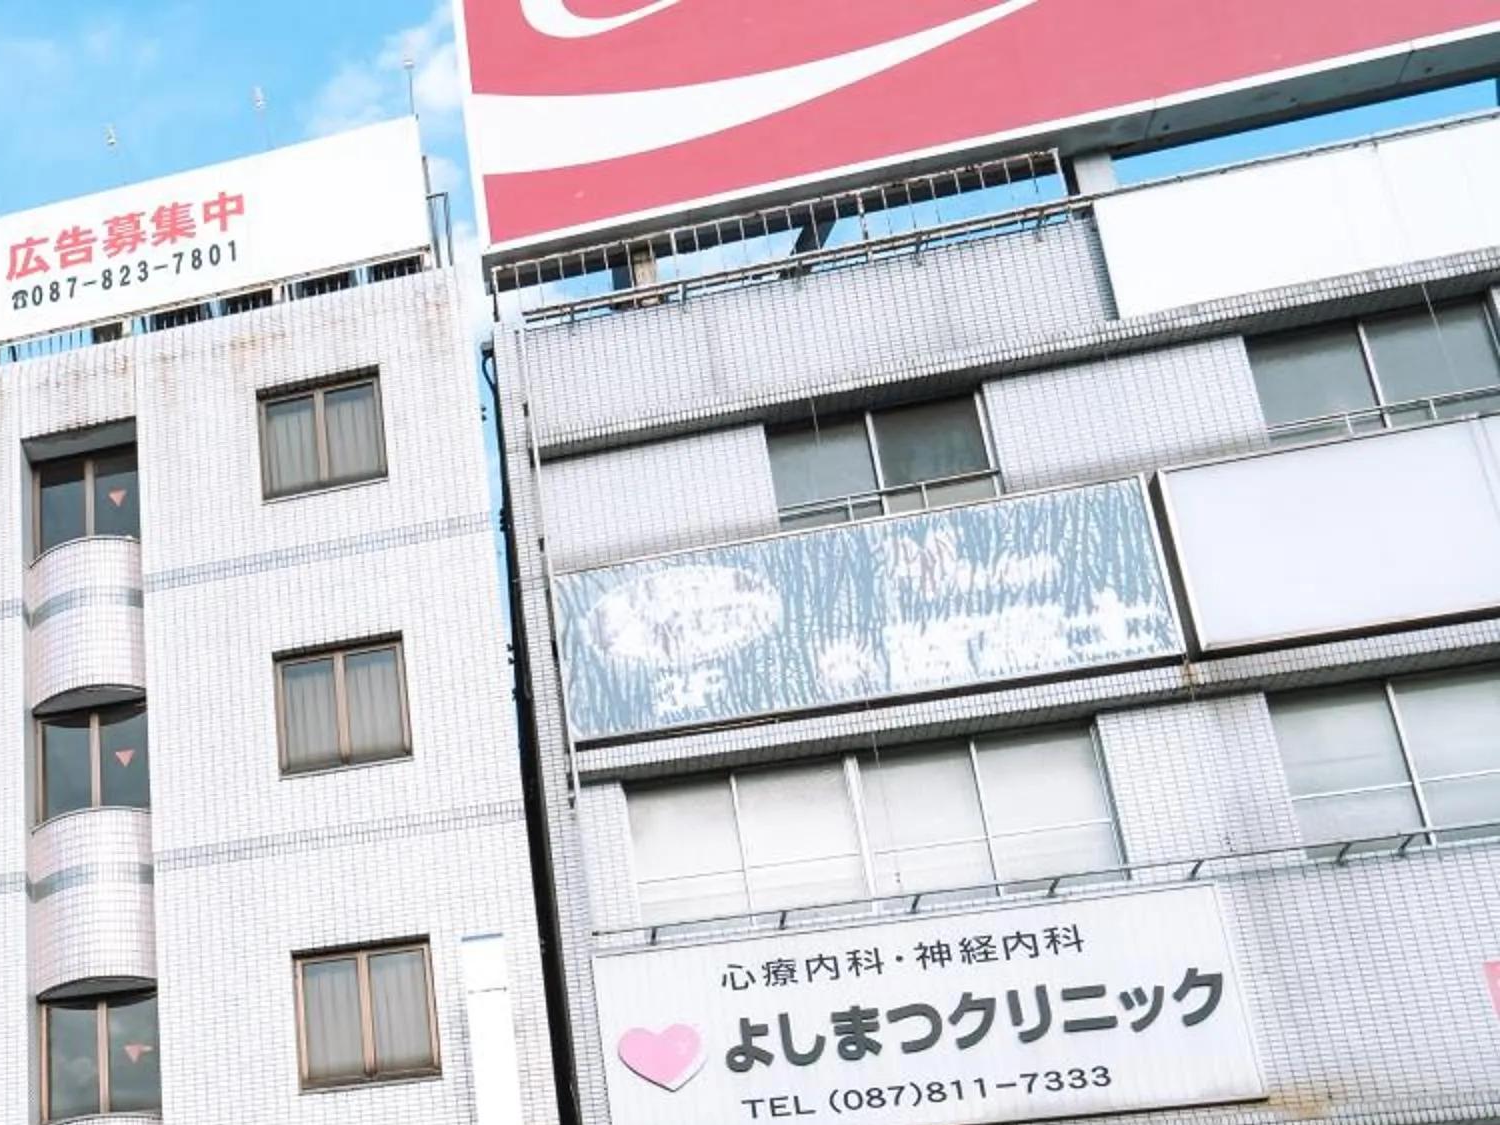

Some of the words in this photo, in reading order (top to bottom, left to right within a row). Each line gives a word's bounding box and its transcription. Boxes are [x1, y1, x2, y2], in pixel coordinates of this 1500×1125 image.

[6, 191, 245, 281] 広告募集中
[721, 924, 1085, 991] 心療内科・神経内科
[725, 967, 1224, 1074] よしまつクリニック
[741, 1098, 816, 1119] TEL
[828, 1065, 1113, 1114] (087)811-7333
